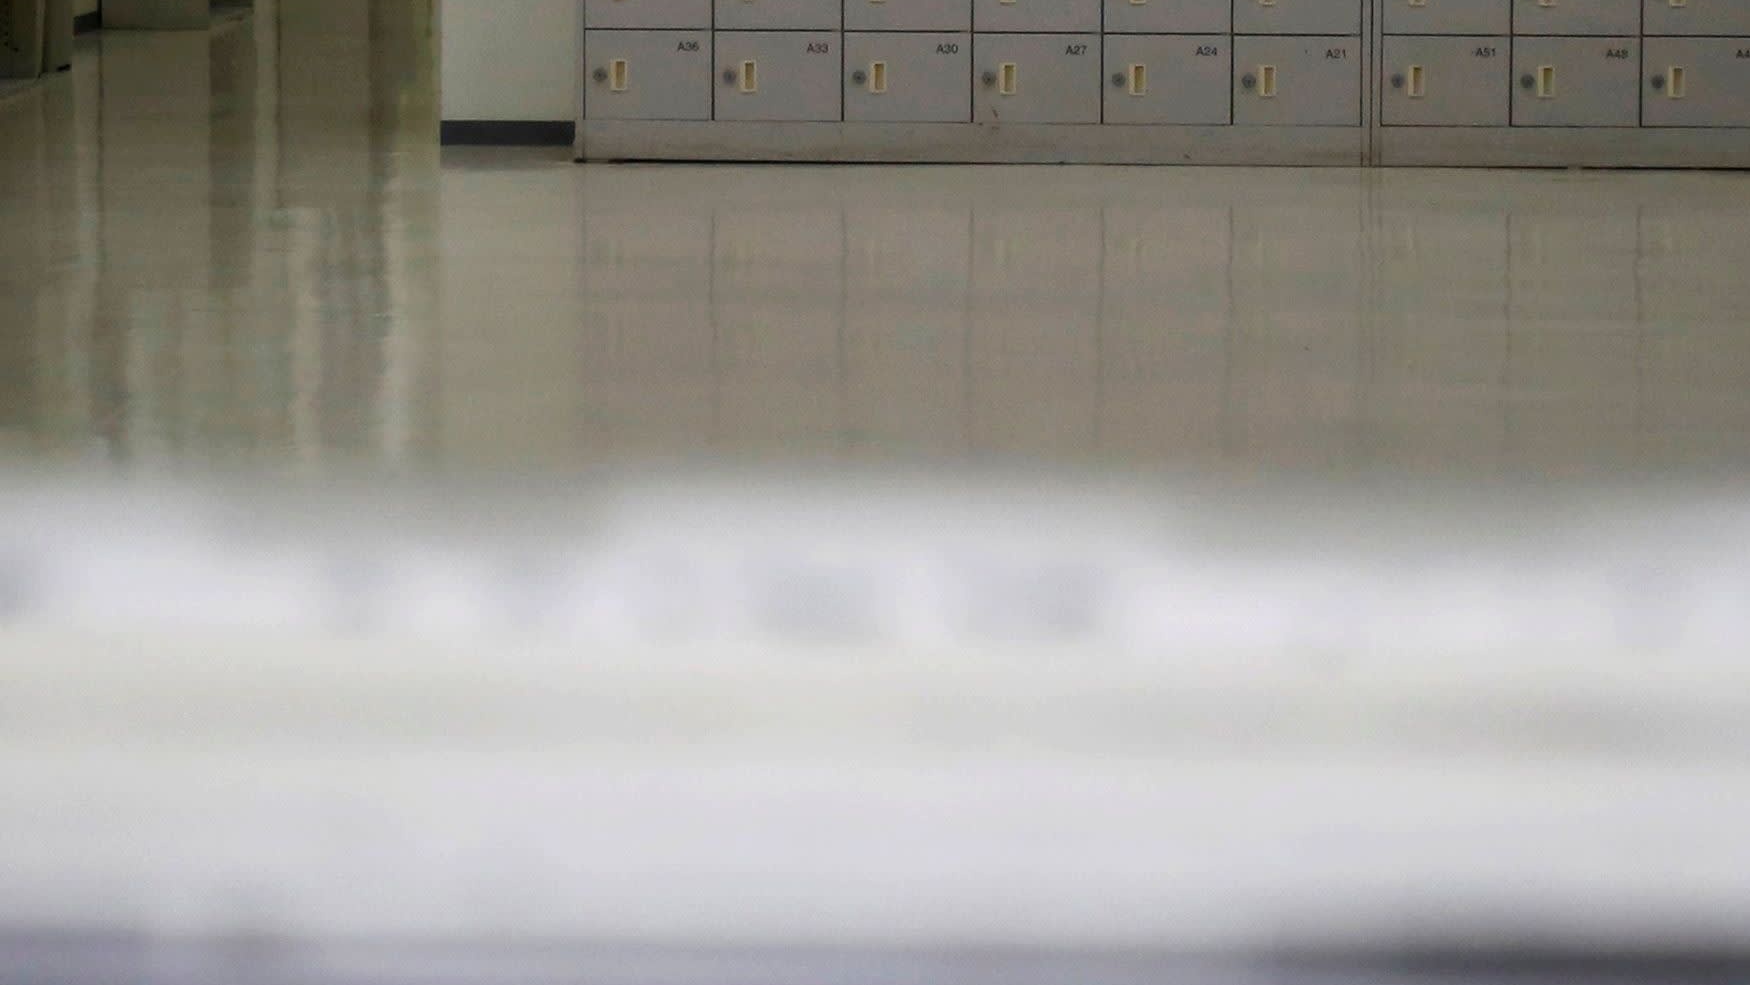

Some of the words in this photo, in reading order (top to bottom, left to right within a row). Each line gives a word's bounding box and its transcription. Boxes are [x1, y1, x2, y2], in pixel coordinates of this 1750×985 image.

[676, 41, 700, 52] A36
[806, 42, 829, 54] A33
[935, 43, 959, 55] A30
[1065, 44, 1088, 56] A27
[1195, 45, 1218, 57] A24
[1325, 48, 1347, 60] A21
